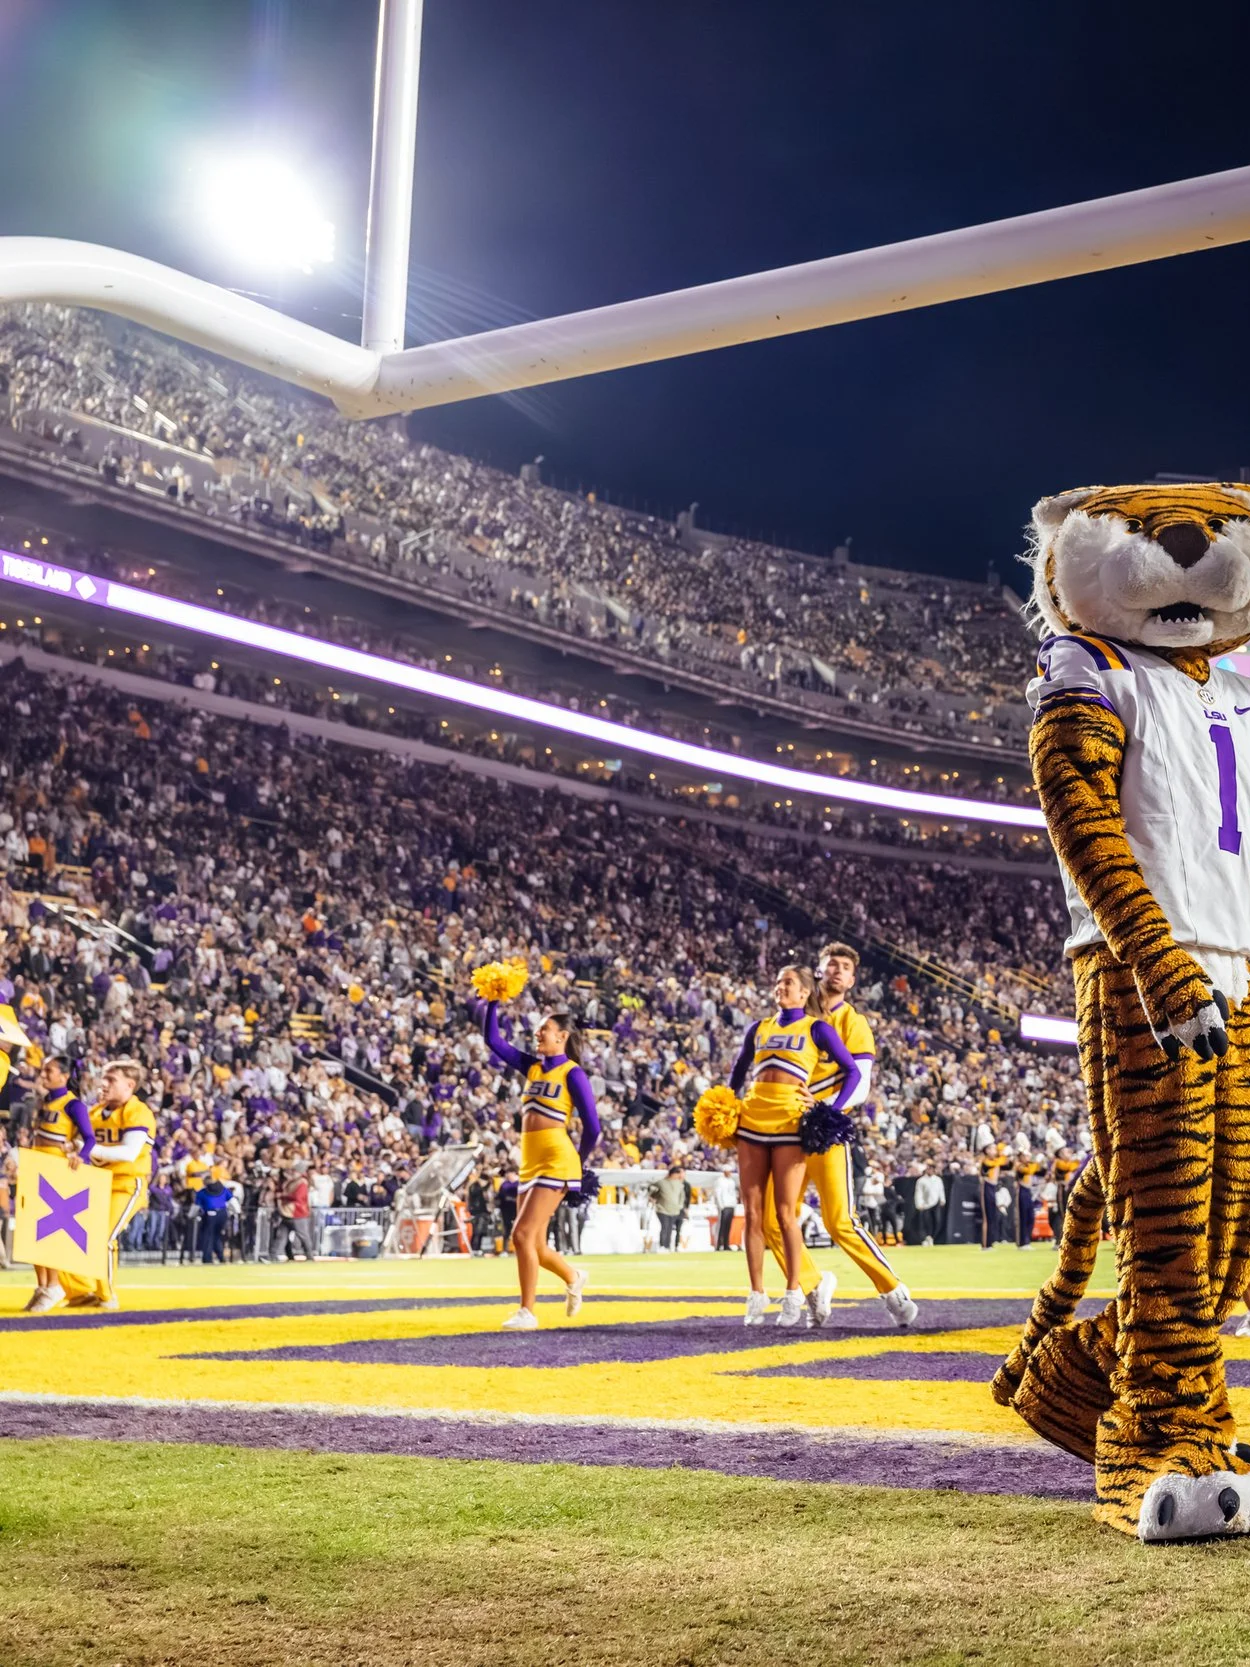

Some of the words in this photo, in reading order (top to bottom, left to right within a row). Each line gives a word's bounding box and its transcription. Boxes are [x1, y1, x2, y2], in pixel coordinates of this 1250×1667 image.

[1203, 709, 1228, 721] LSU
[1209, 724, 1242, 856] 1
[756, 1034, 806, 1051] LSU
[36, 1173, 90, 1255] X
